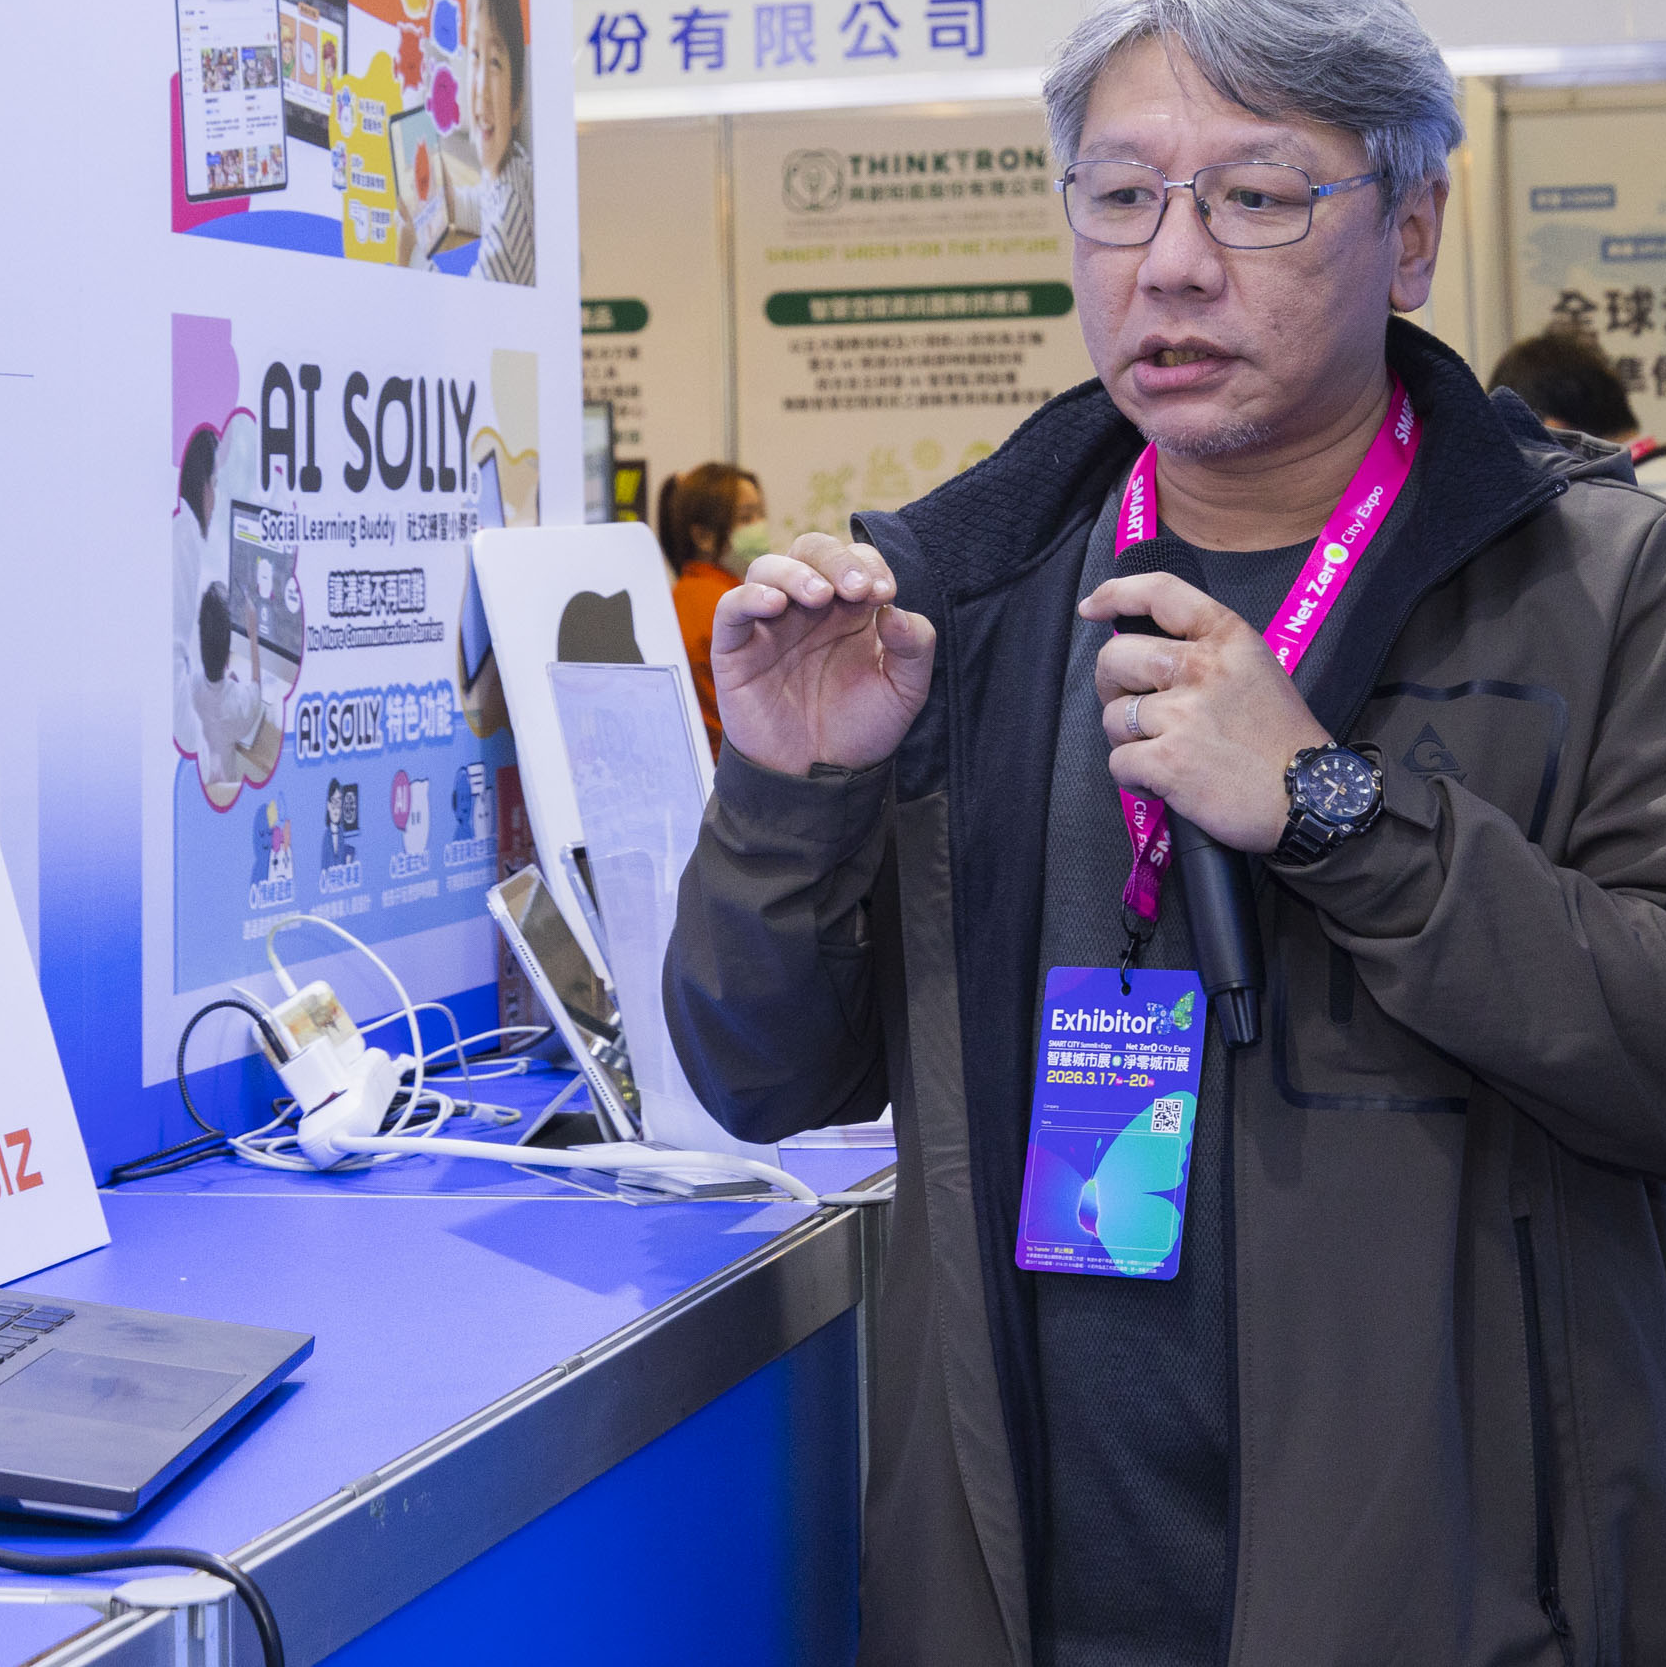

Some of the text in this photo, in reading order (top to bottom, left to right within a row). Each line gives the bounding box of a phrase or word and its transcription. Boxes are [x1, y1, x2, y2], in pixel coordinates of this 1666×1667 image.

[848, 144, 1049, 182] THINKTRON
[260, 360, 481, 494] AI SOLLY
[1126, 474, 1145, 541] SMART
[260, 510, 396, 547] Social Learning Buddy
[1284, 597, 1318, 634] Net
[1341, 518, 1366, 545] City
[1357, 485, 1384, 520] Expo
[299, 703, 322, 757] AI
[327, 694, 384, 751] SOLLY
[1132, 800, 1148, 831] City
[1050, 1007, 1157, 1035] Exhibitor
[1046, 1050, 1112, 1069] 智慧城市展
[1125, 1042, 1140, 1051] Net
[1158, 1044, 1173, 1053] City
[1173, 1045, 1191, 1054] Expo
